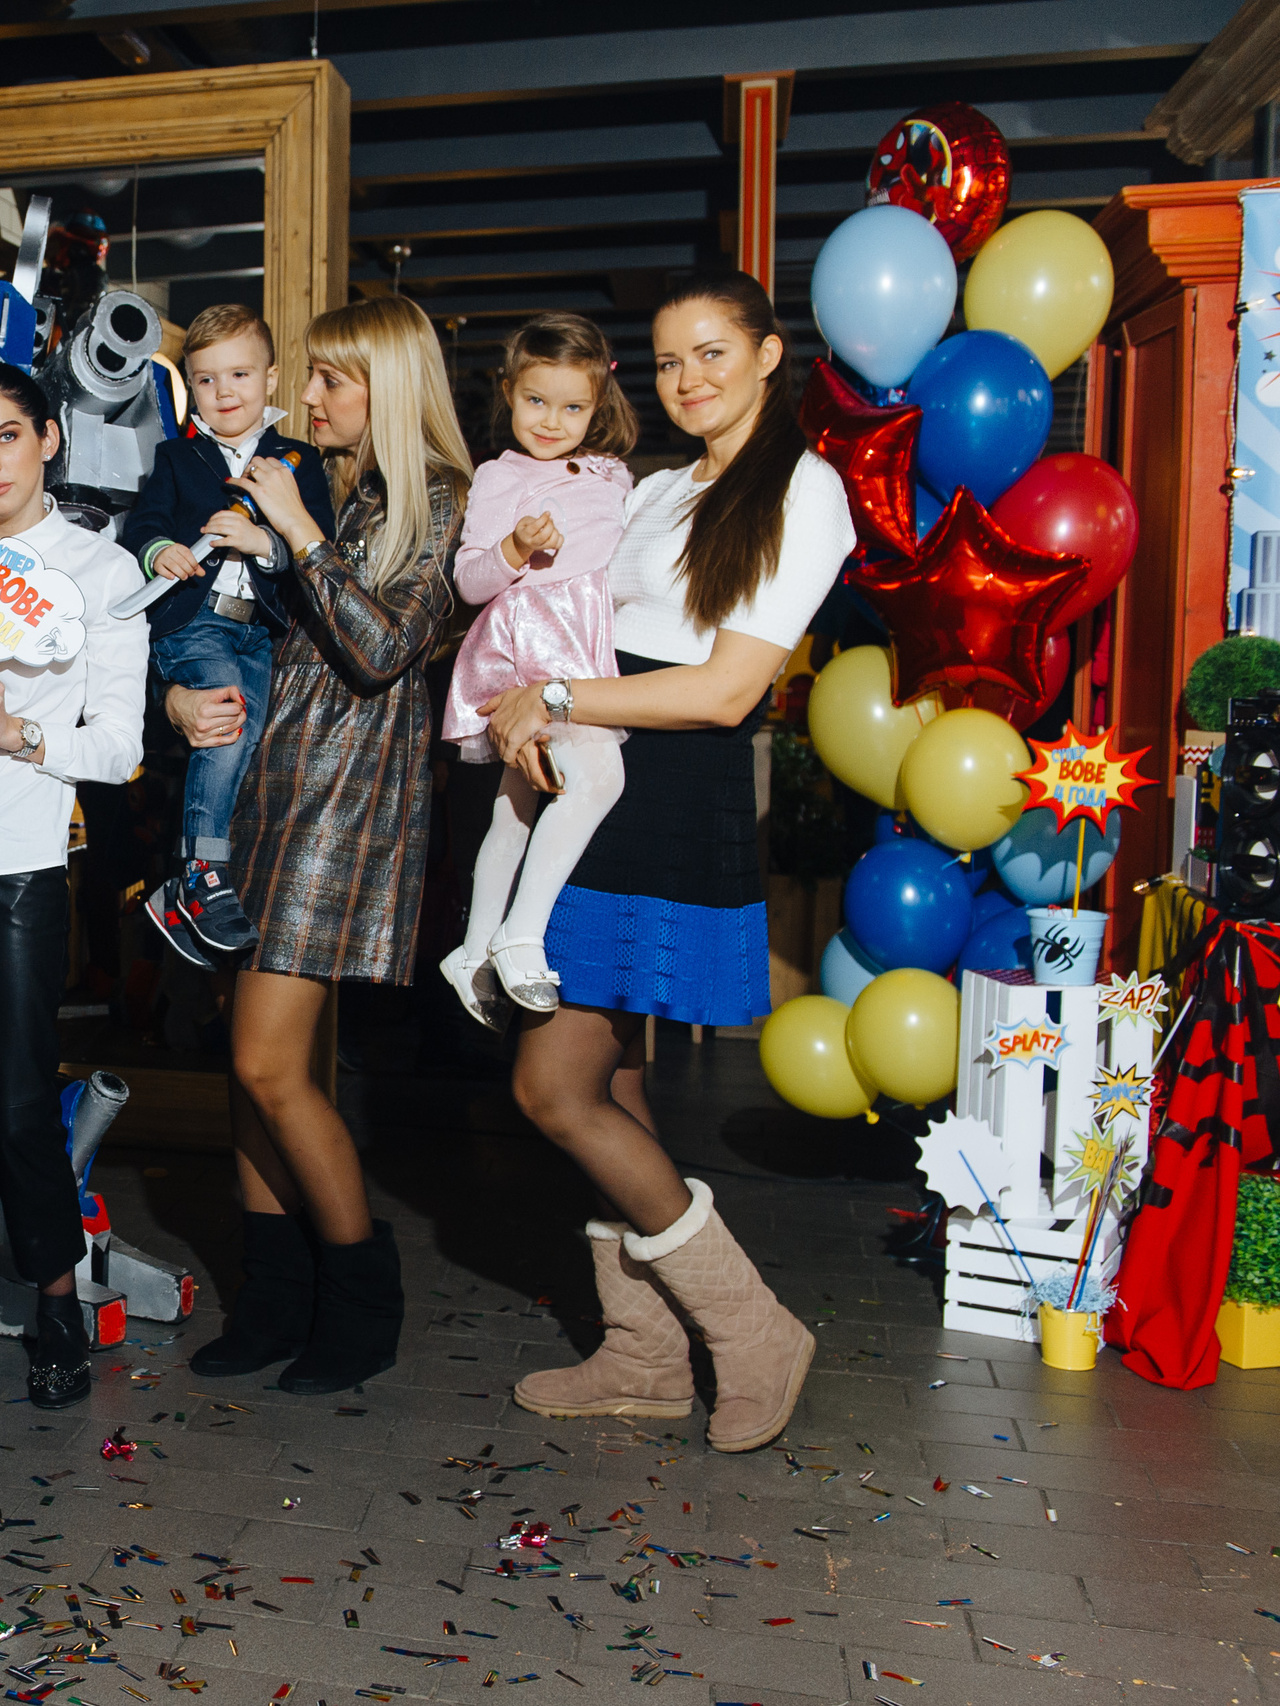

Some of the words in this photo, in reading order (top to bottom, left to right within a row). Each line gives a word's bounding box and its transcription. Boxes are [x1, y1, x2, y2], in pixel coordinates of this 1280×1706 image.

[1051, 745, 1087, 763] СУПЕР
[1058, 759, 1107, 784] ВОВЕ
[1053, 784, 1065, 803] 4
[1067, 786, 1107, 808] ГОДА
[1101, 984, 1160, 1015] ZAP!
[999, 1030, 1062, 1056] SPLAT!
[1100, 1083, 1144, 1103] BANG!
